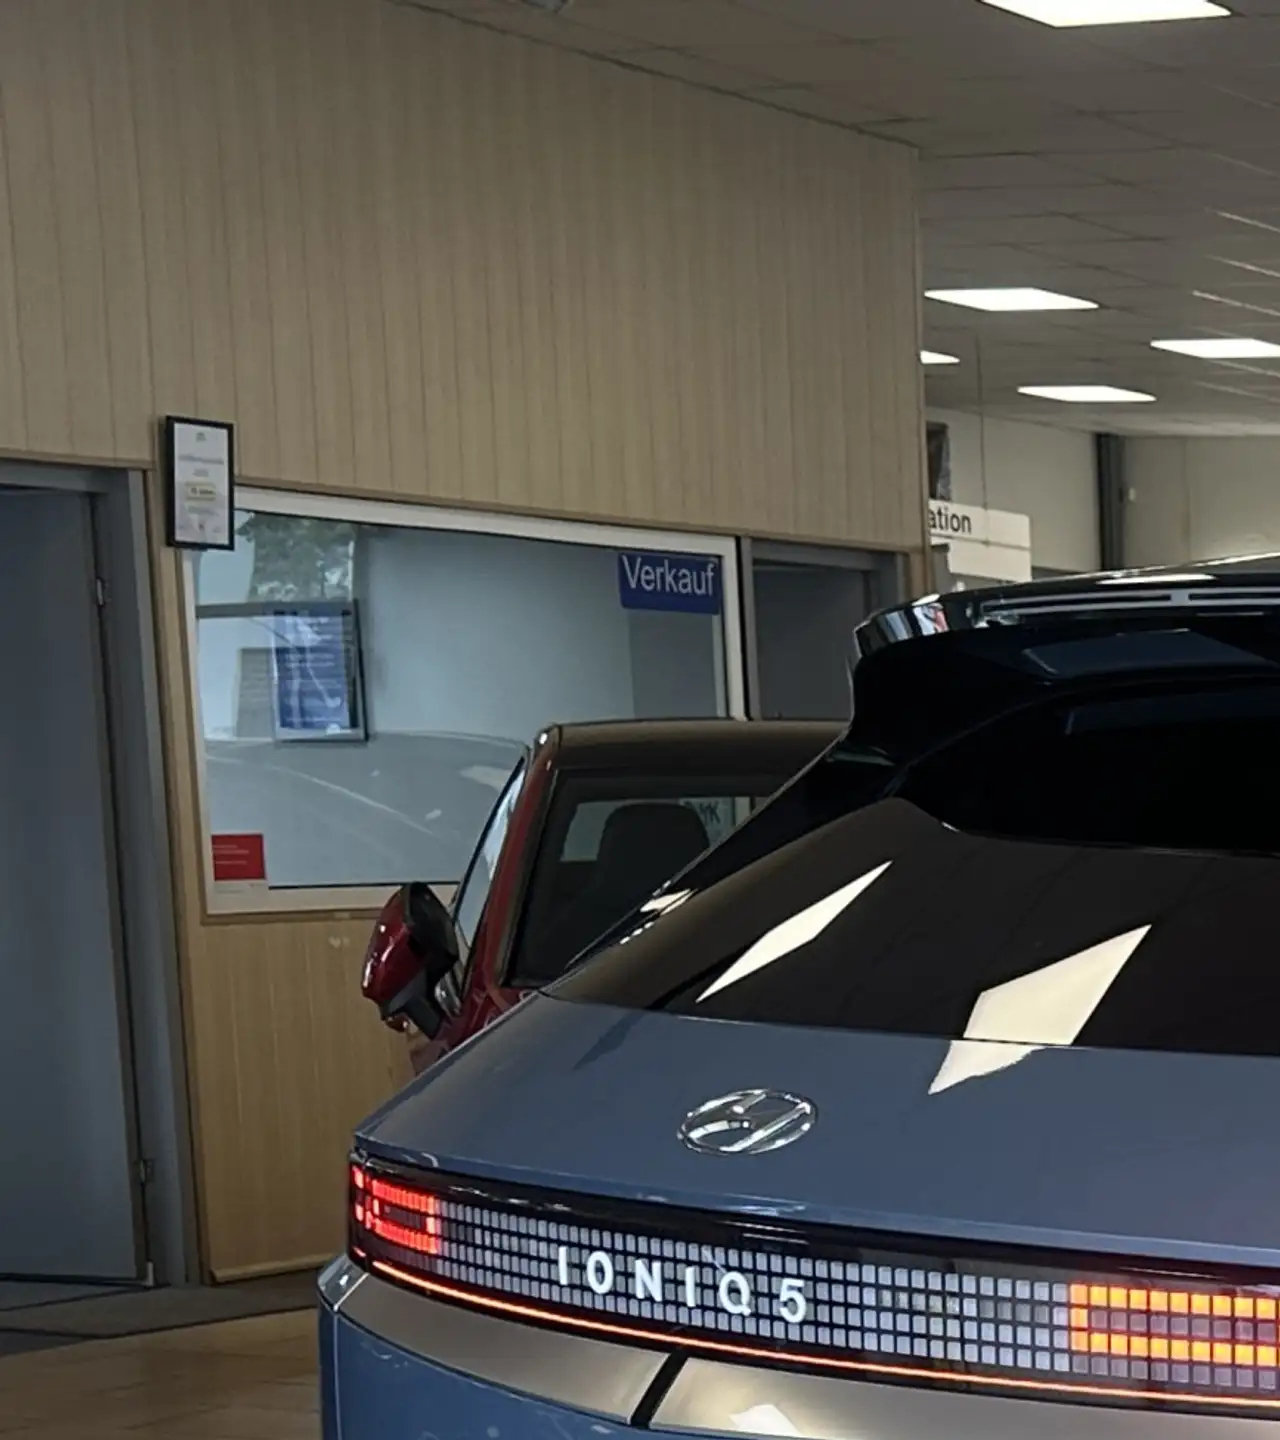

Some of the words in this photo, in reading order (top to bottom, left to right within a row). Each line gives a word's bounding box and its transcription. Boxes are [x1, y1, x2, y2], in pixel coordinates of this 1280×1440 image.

[622, 555, 716, 596] Verkauf
[558, 1245, 751, 1316] IONIQ
[779, 1278, 807, 1323] 5
